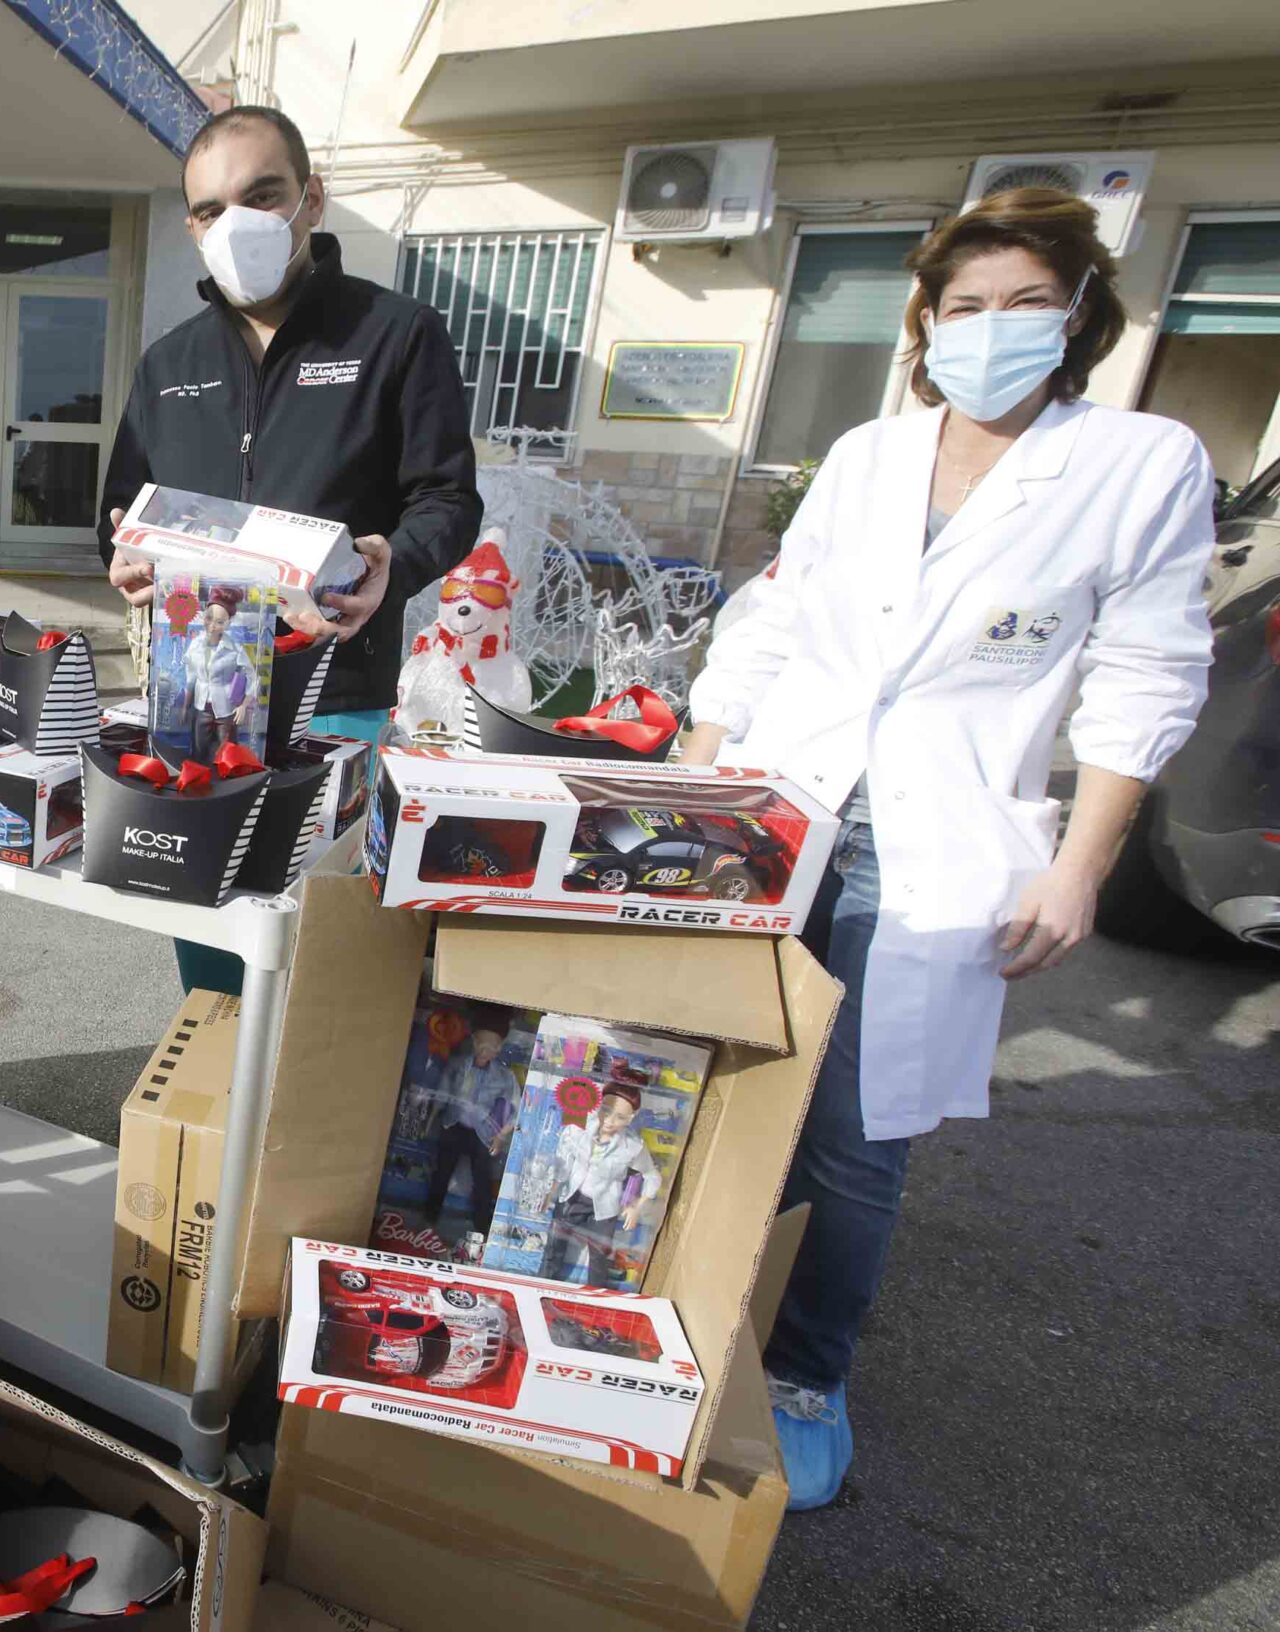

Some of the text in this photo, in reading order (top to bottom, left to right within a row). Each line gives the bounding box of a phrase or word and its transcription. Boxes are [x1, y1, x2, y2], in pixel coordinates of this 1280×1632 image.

[585, 760, 691, 774] Radiocomandata
[404, 783, 571, 802] RACER CAR
[123, 826, 189, 852] KOST
[0, 849, 30, 866] CAR
[122, 845, 185, 865] MAKE-UP ITALIA
[654, 868, 681, 884] 98
[488, 890, 515, 899] SCALA
[619, 906, 793, 930] RACER CAR
[378, 1212, 447, 1254] Barbie
[177, 1220, 205, 1280] FRM12
[304, 1241, 454, 1274] RACER CAR
[535, 1362, 699, 1402] RACER CAR
[371, 1402, 582, 1451] Simulation Racer Car Radiocomandata
